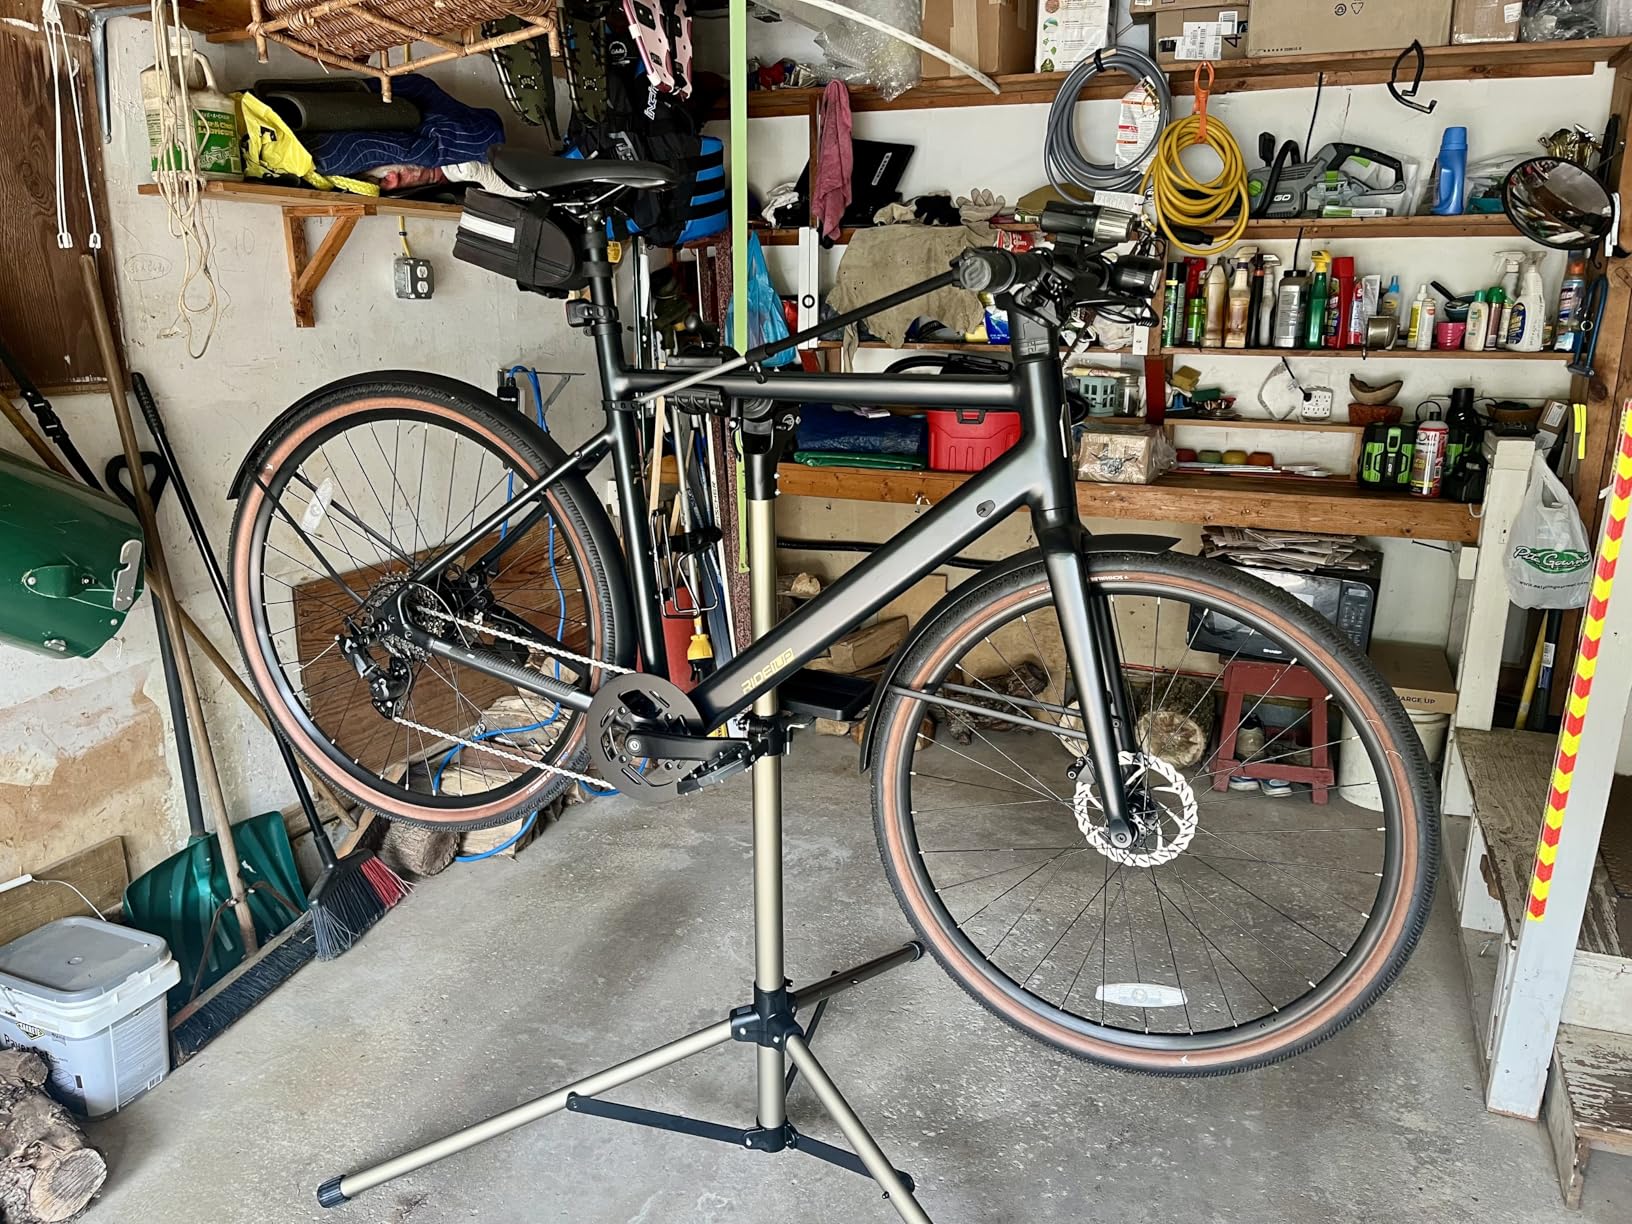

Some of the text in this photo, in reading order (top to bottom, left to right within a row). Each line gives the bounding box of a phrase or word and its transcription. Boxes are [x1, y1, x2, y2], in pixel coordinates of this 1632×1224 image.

[1224, 37, 1242, 48] 4
[1273, 194, 1292, 203] GO
[1424, 697, 1436, 705] UP
